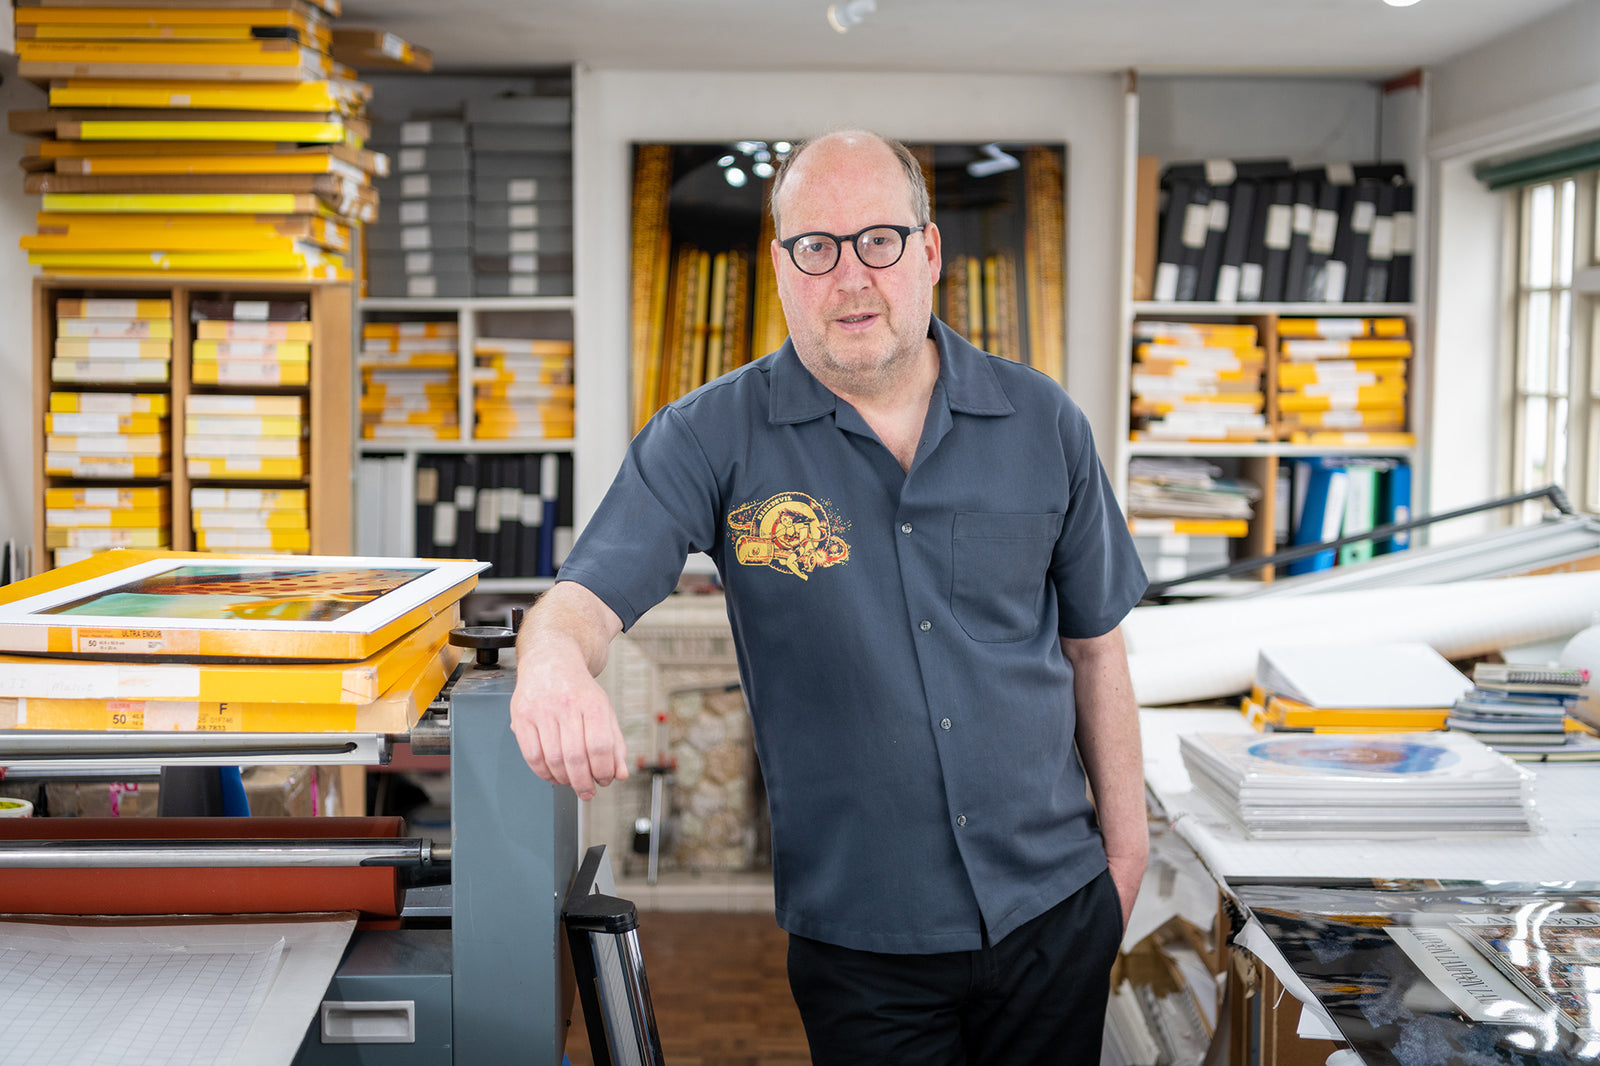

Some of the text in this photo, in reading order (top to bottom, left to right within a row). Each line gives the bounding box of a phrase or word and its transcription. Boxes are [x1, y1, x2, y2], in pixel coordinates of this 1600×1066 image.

[122, 630, 141, 638] ULTRA
[219, 703, 228, 715] F
[112, 714, 127, 724] 50
